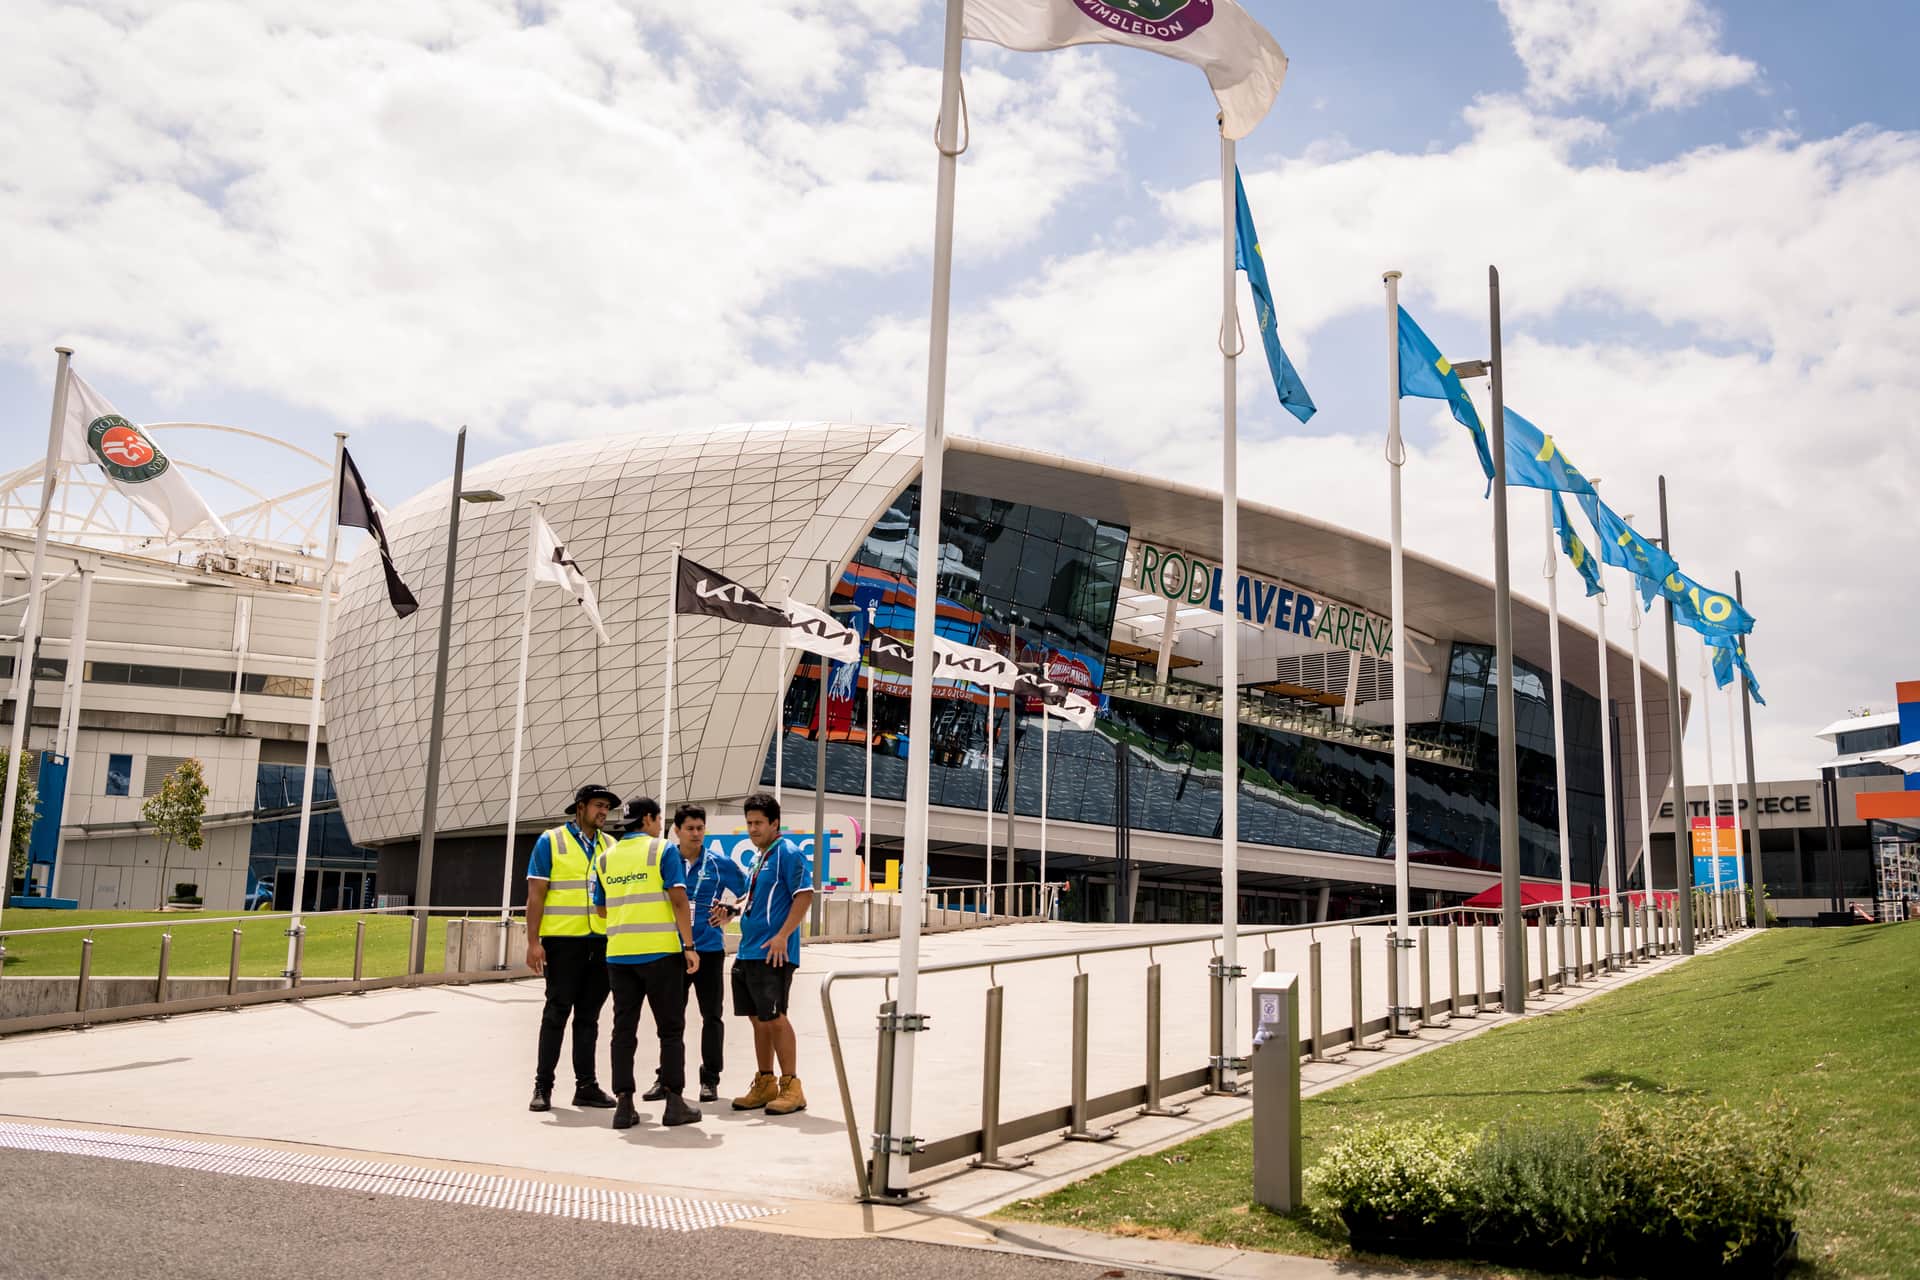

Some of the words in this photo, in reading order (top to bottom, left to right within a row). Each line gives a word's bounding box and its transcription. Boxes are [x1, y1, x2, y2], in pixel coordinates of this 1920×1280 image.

[1140, 545, 1210, 605] ROD
[1209, 567, 1316, 638] LAVER
[606, 871, 648, 885] Quayclean
